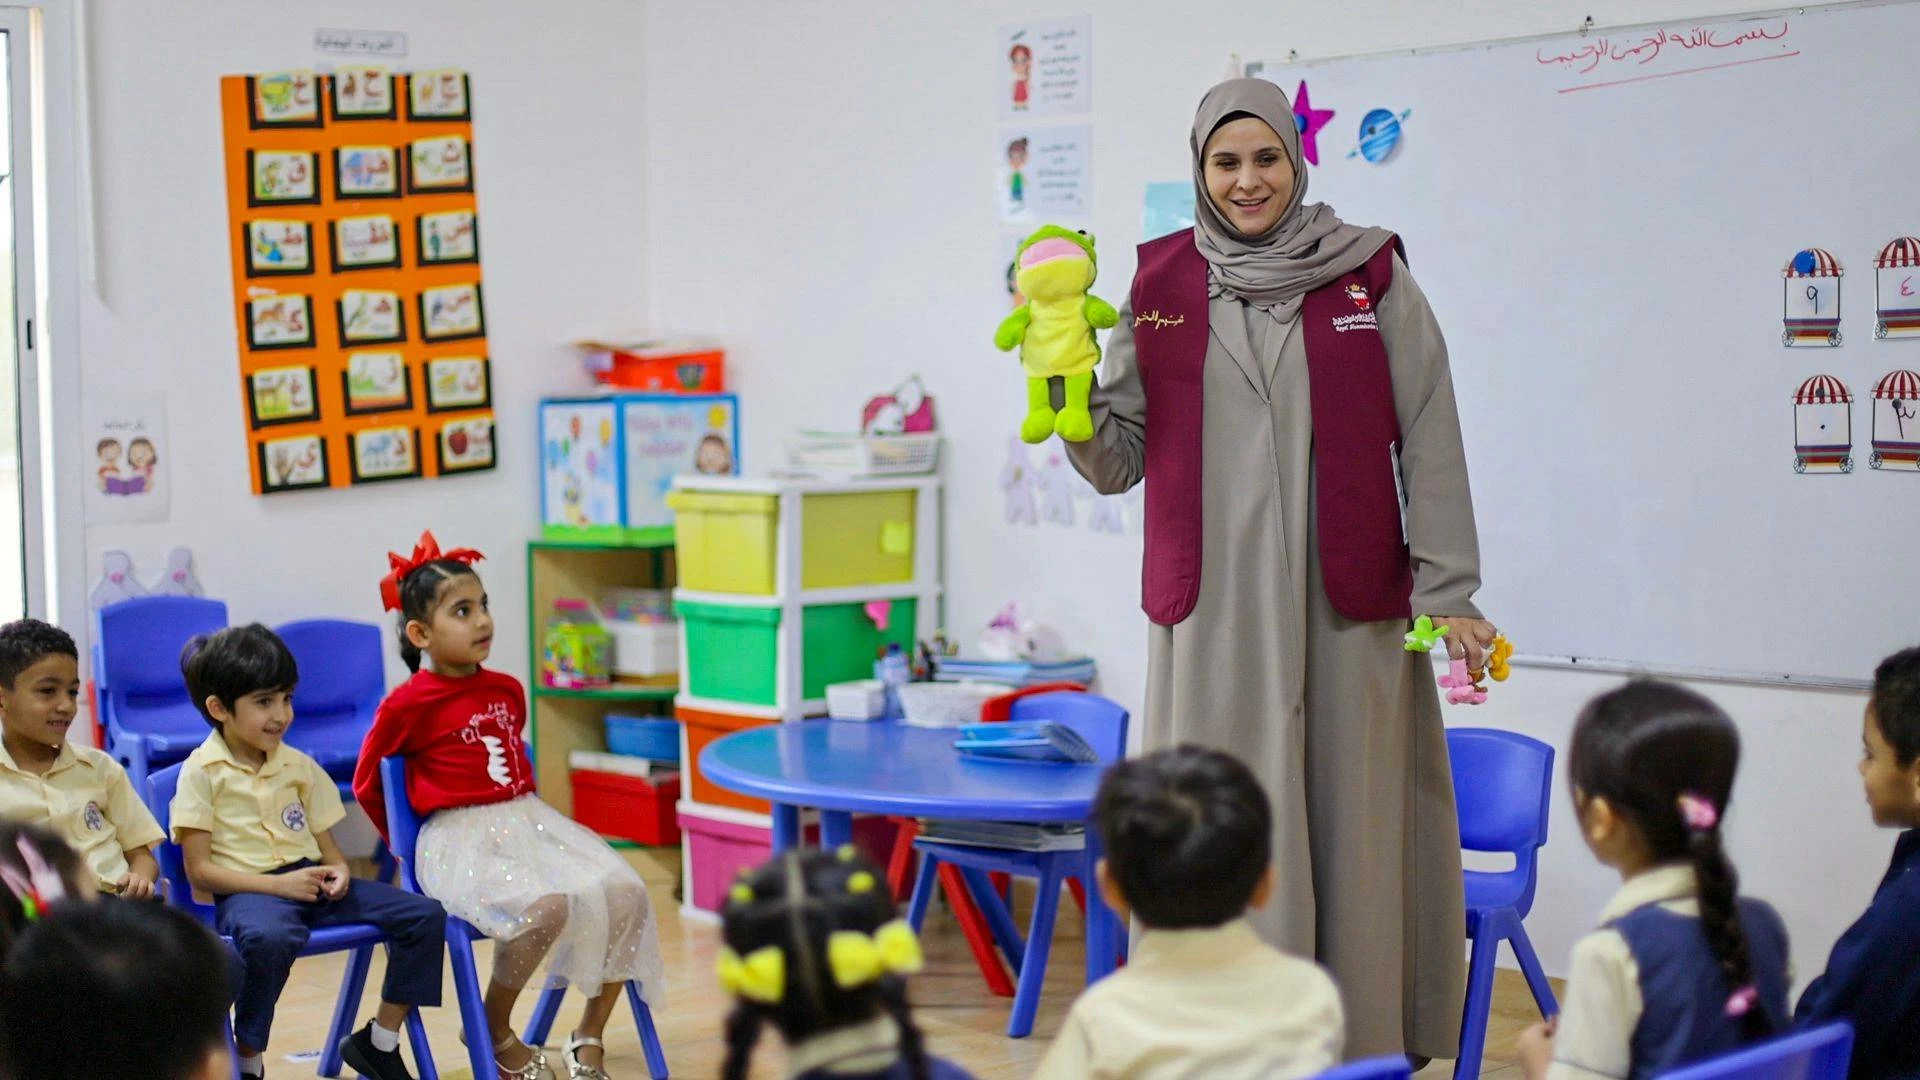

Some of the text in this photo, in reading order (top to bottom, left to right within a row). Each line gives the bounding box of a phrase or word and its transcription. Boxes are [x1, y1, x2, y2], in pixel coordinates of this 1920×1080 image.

[1536, 22, 1788, 74] بسم الله الرحمن الرحيم
